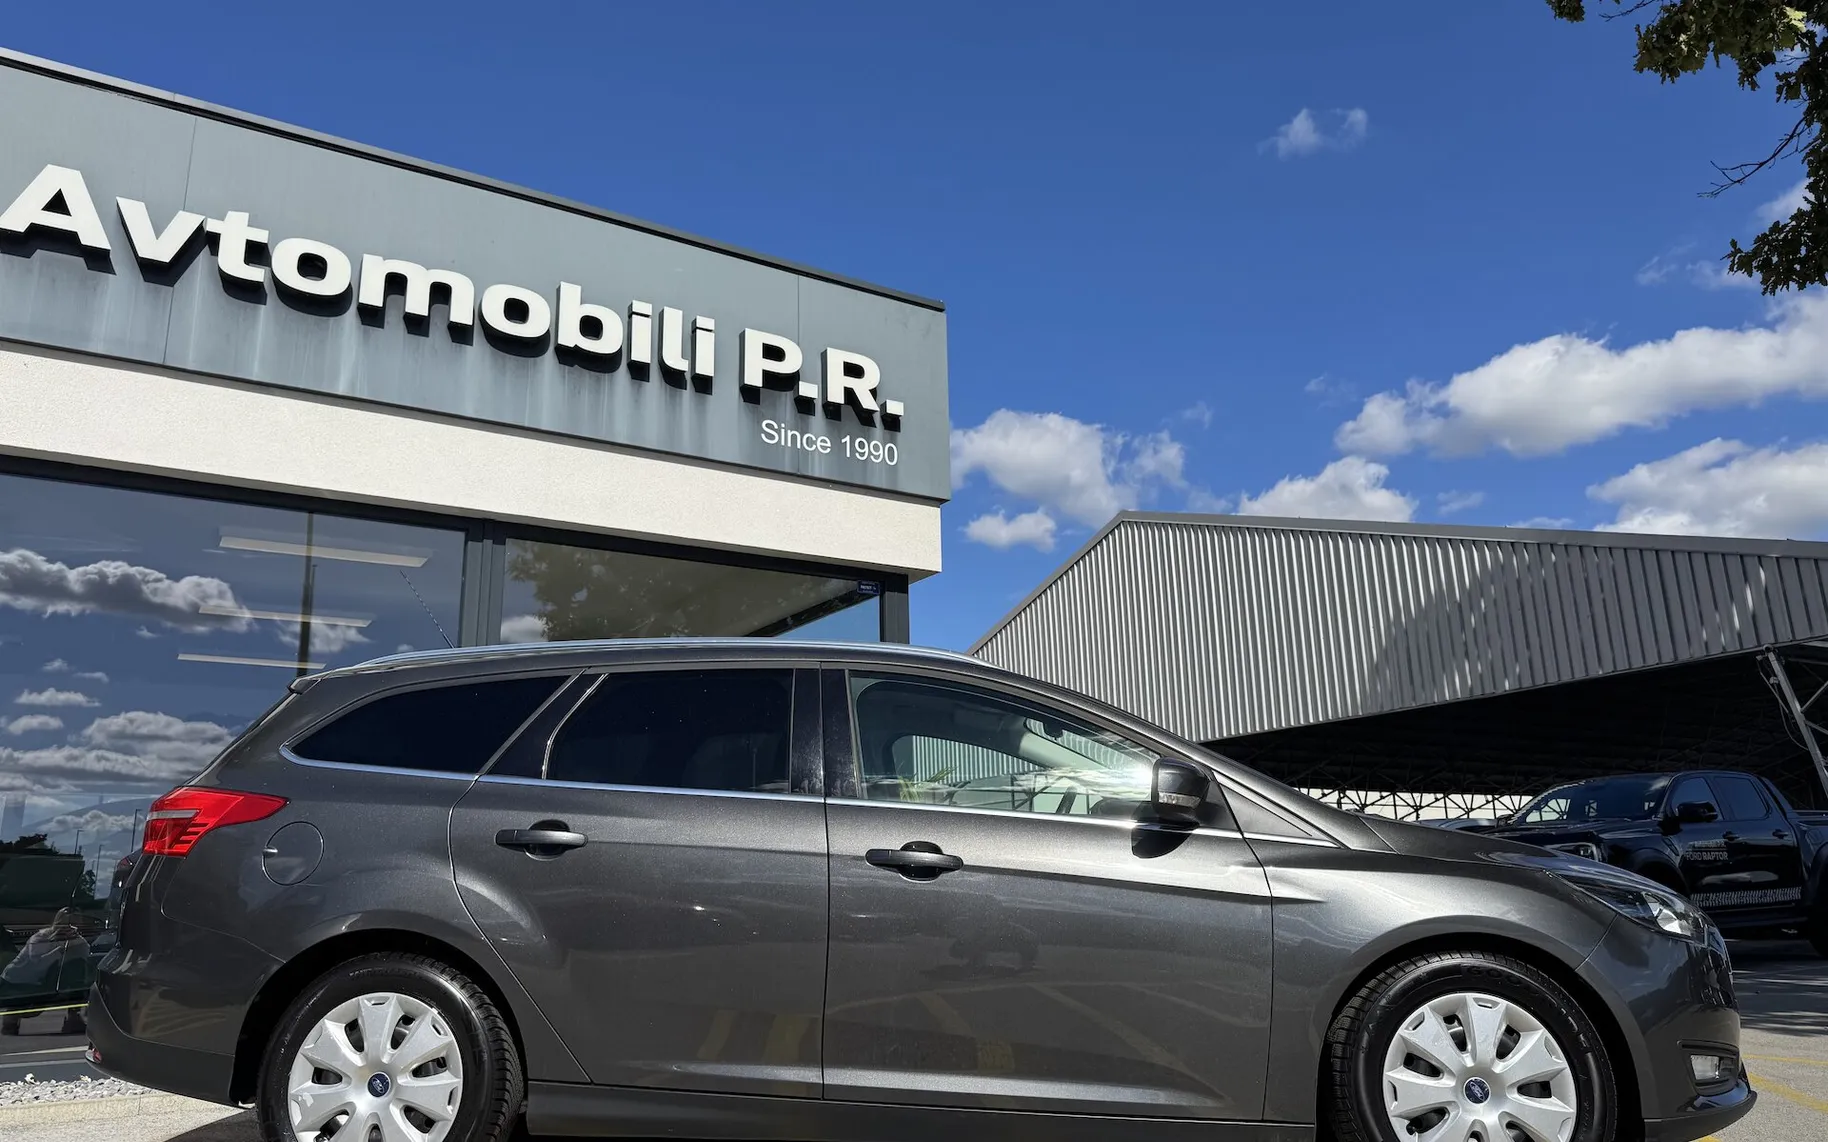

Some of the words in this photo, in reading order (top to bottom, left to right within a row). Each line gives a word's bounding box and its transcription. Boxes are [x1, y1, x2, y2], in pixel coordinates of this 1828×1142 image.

[0, 164, 715, 377] Avtomobili
[743, 327, 904, 417] P.R.
[761, 419, 832, 454] Since
[841, 434, 898, 466] 1990
[1702, 851, 1728, 860] RAPTOR
